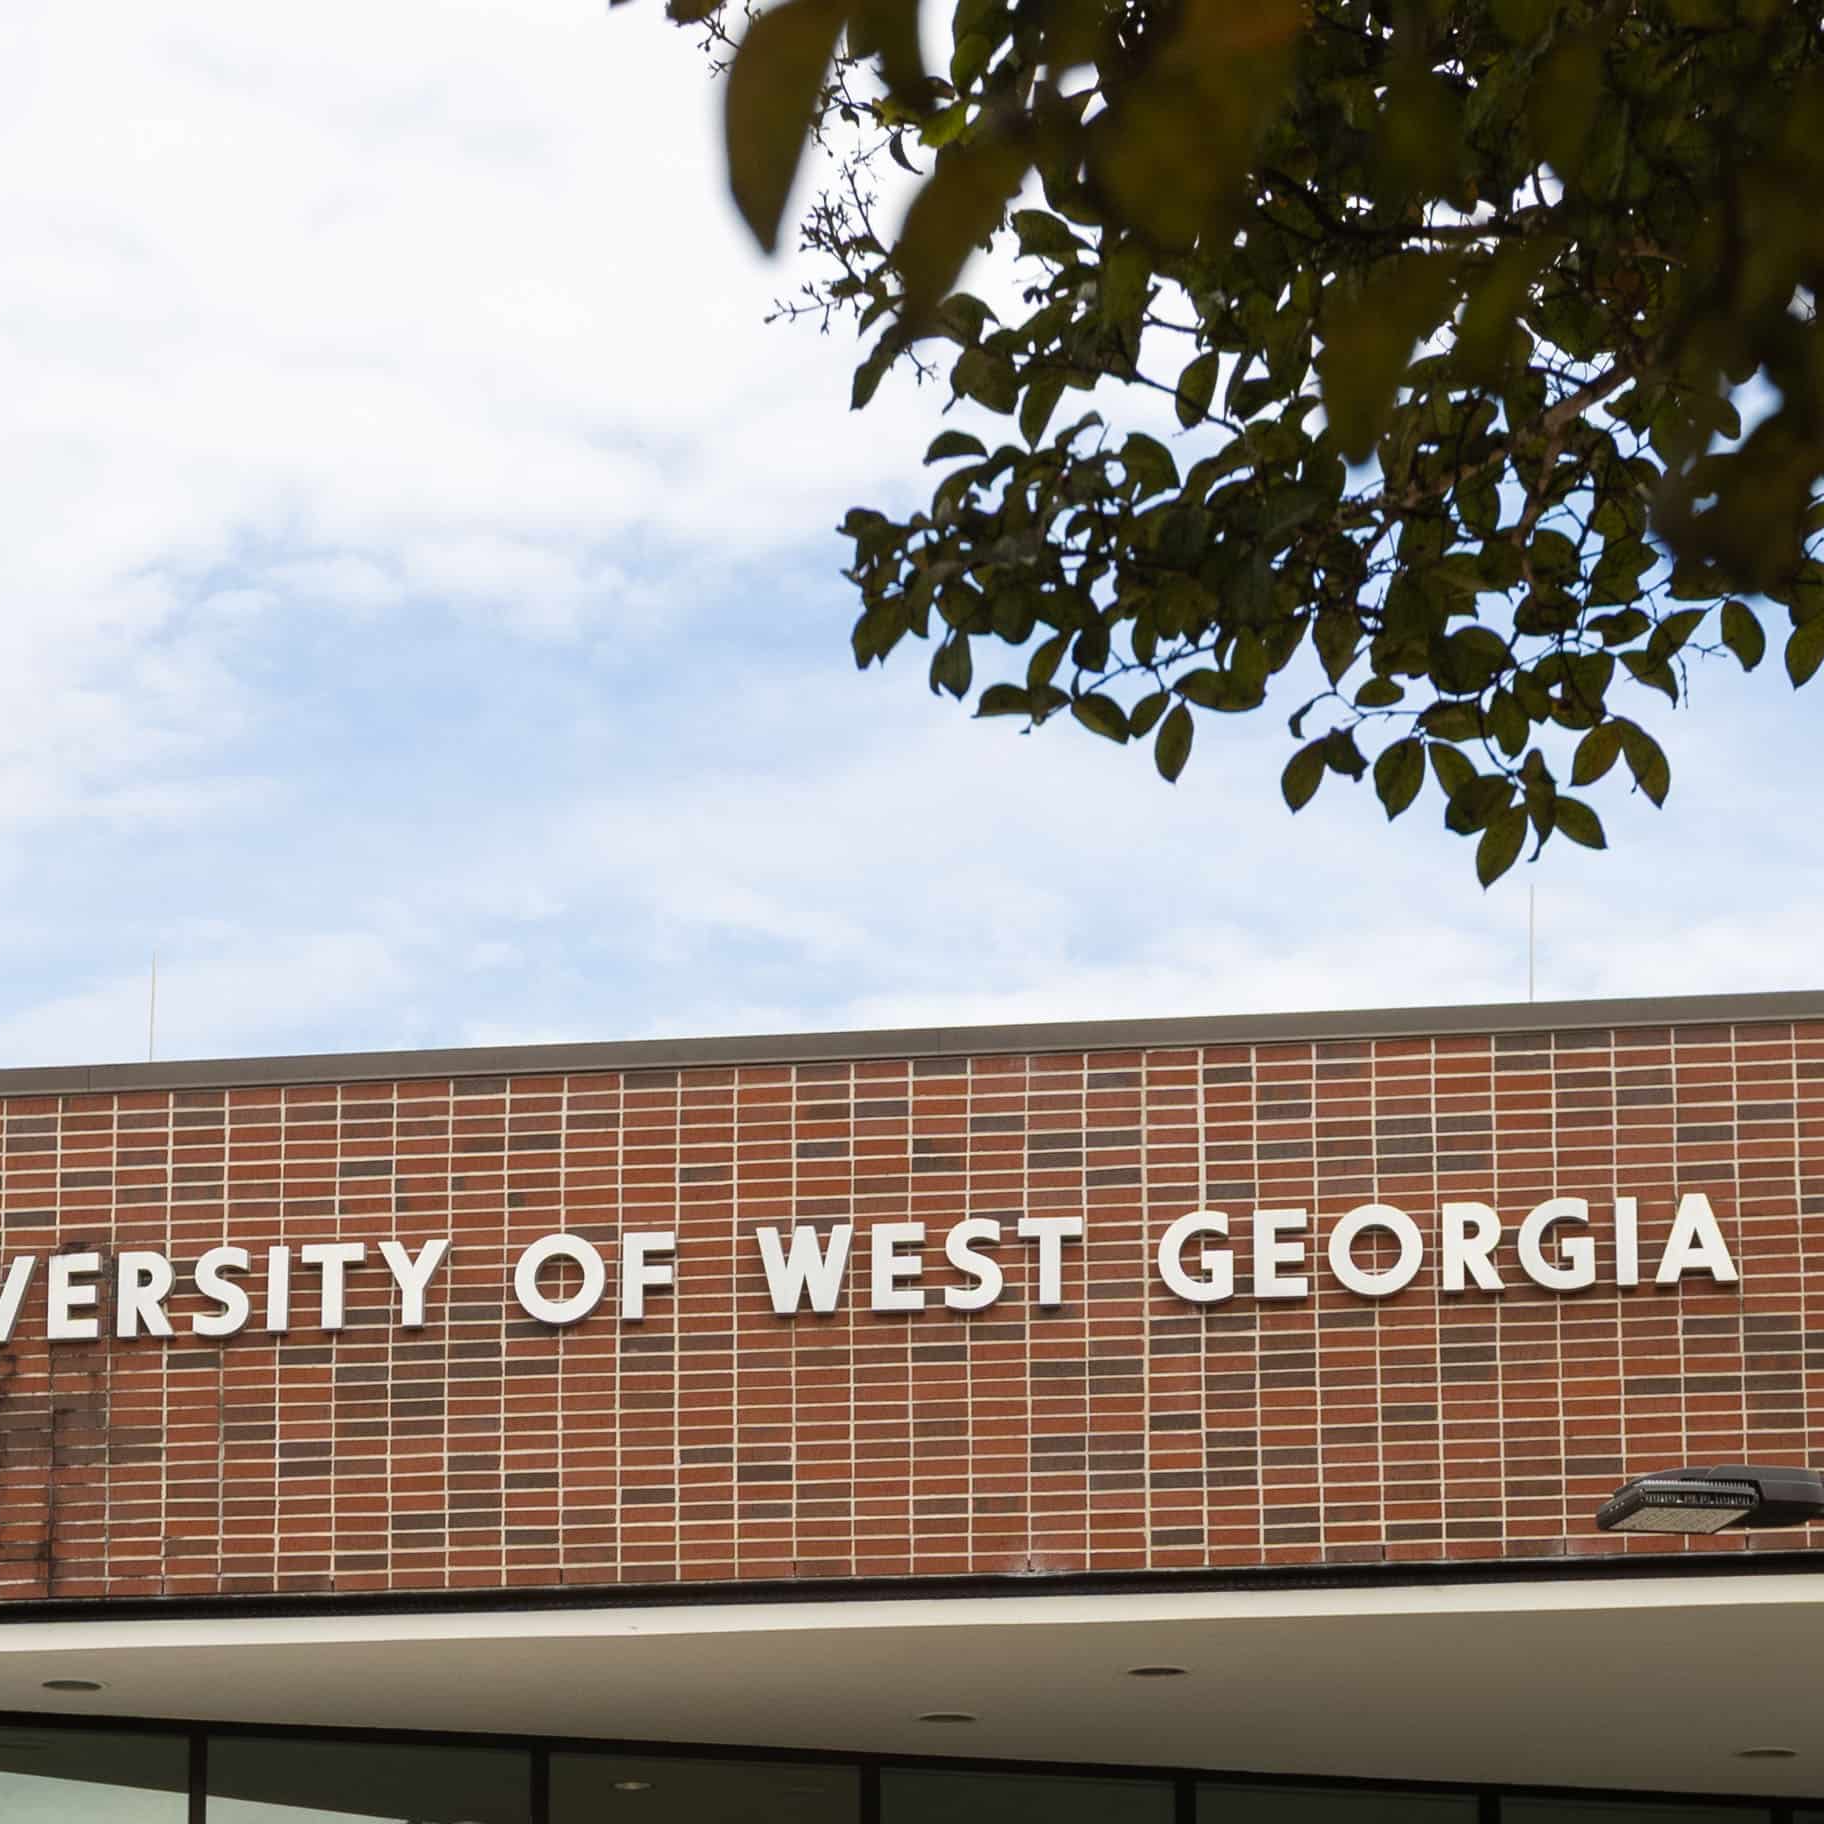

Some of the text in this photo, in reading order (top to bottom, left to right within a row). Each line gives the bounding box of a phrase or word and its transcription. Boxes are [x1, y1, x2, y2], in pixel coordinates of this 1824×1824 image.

[511, 1229, 676, 1325] OF
[754, 1215, 1084, 1316] WEST
[1155, 1192, 1739, 1304] GEORGIA
